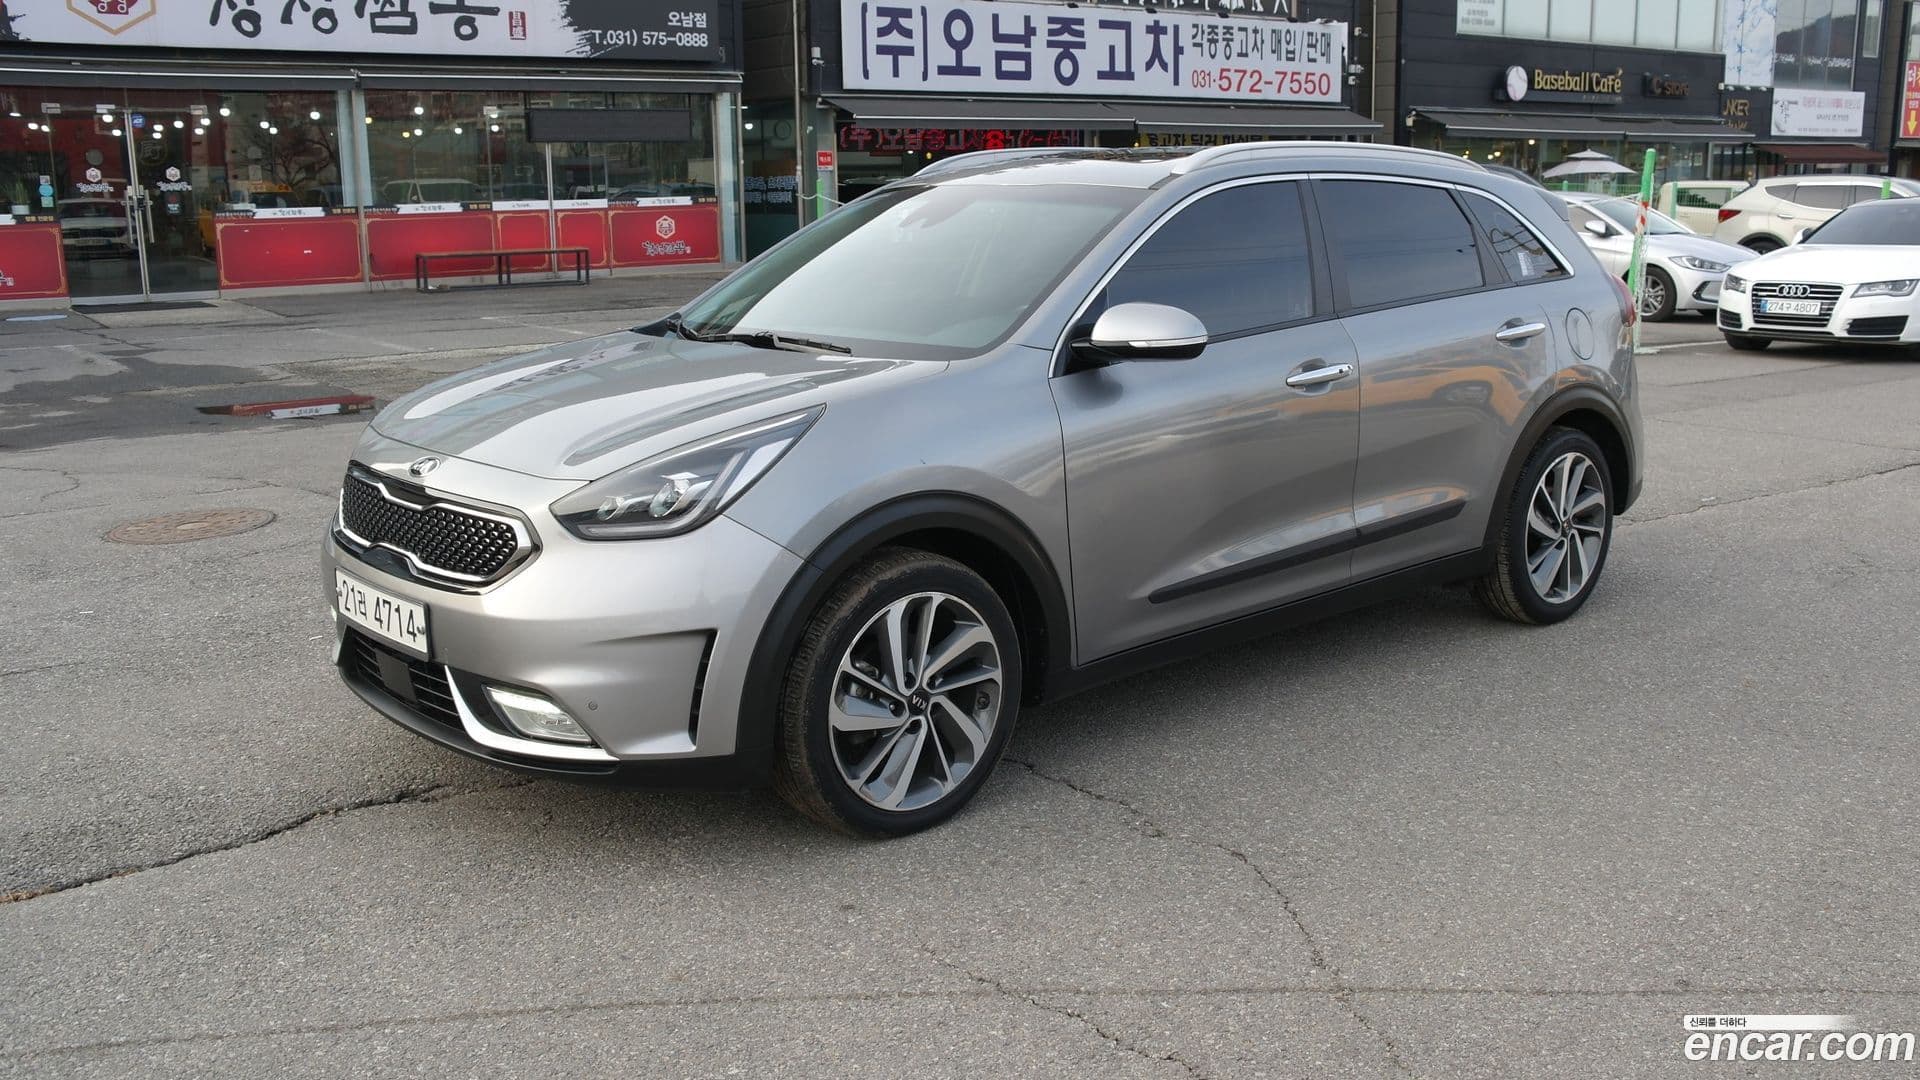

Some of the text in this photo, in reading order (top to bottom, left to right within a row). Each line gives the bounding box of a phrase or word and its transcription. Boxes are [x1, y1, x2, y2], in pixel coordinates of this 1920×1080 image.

[667, 11, 707, 28] 오남점
[593, 30, 708, 47] T.031) 575-0888
[861, 2, 1184, 87] (주)오남중고차
[1192, 23, 1331, 64] 각종중고차 매입/판매
[1534, 69, 1589, 91] Baseball
[1793, 303, 1818, 313] 4807
[343, 580, 417, 642] 21러 4714
